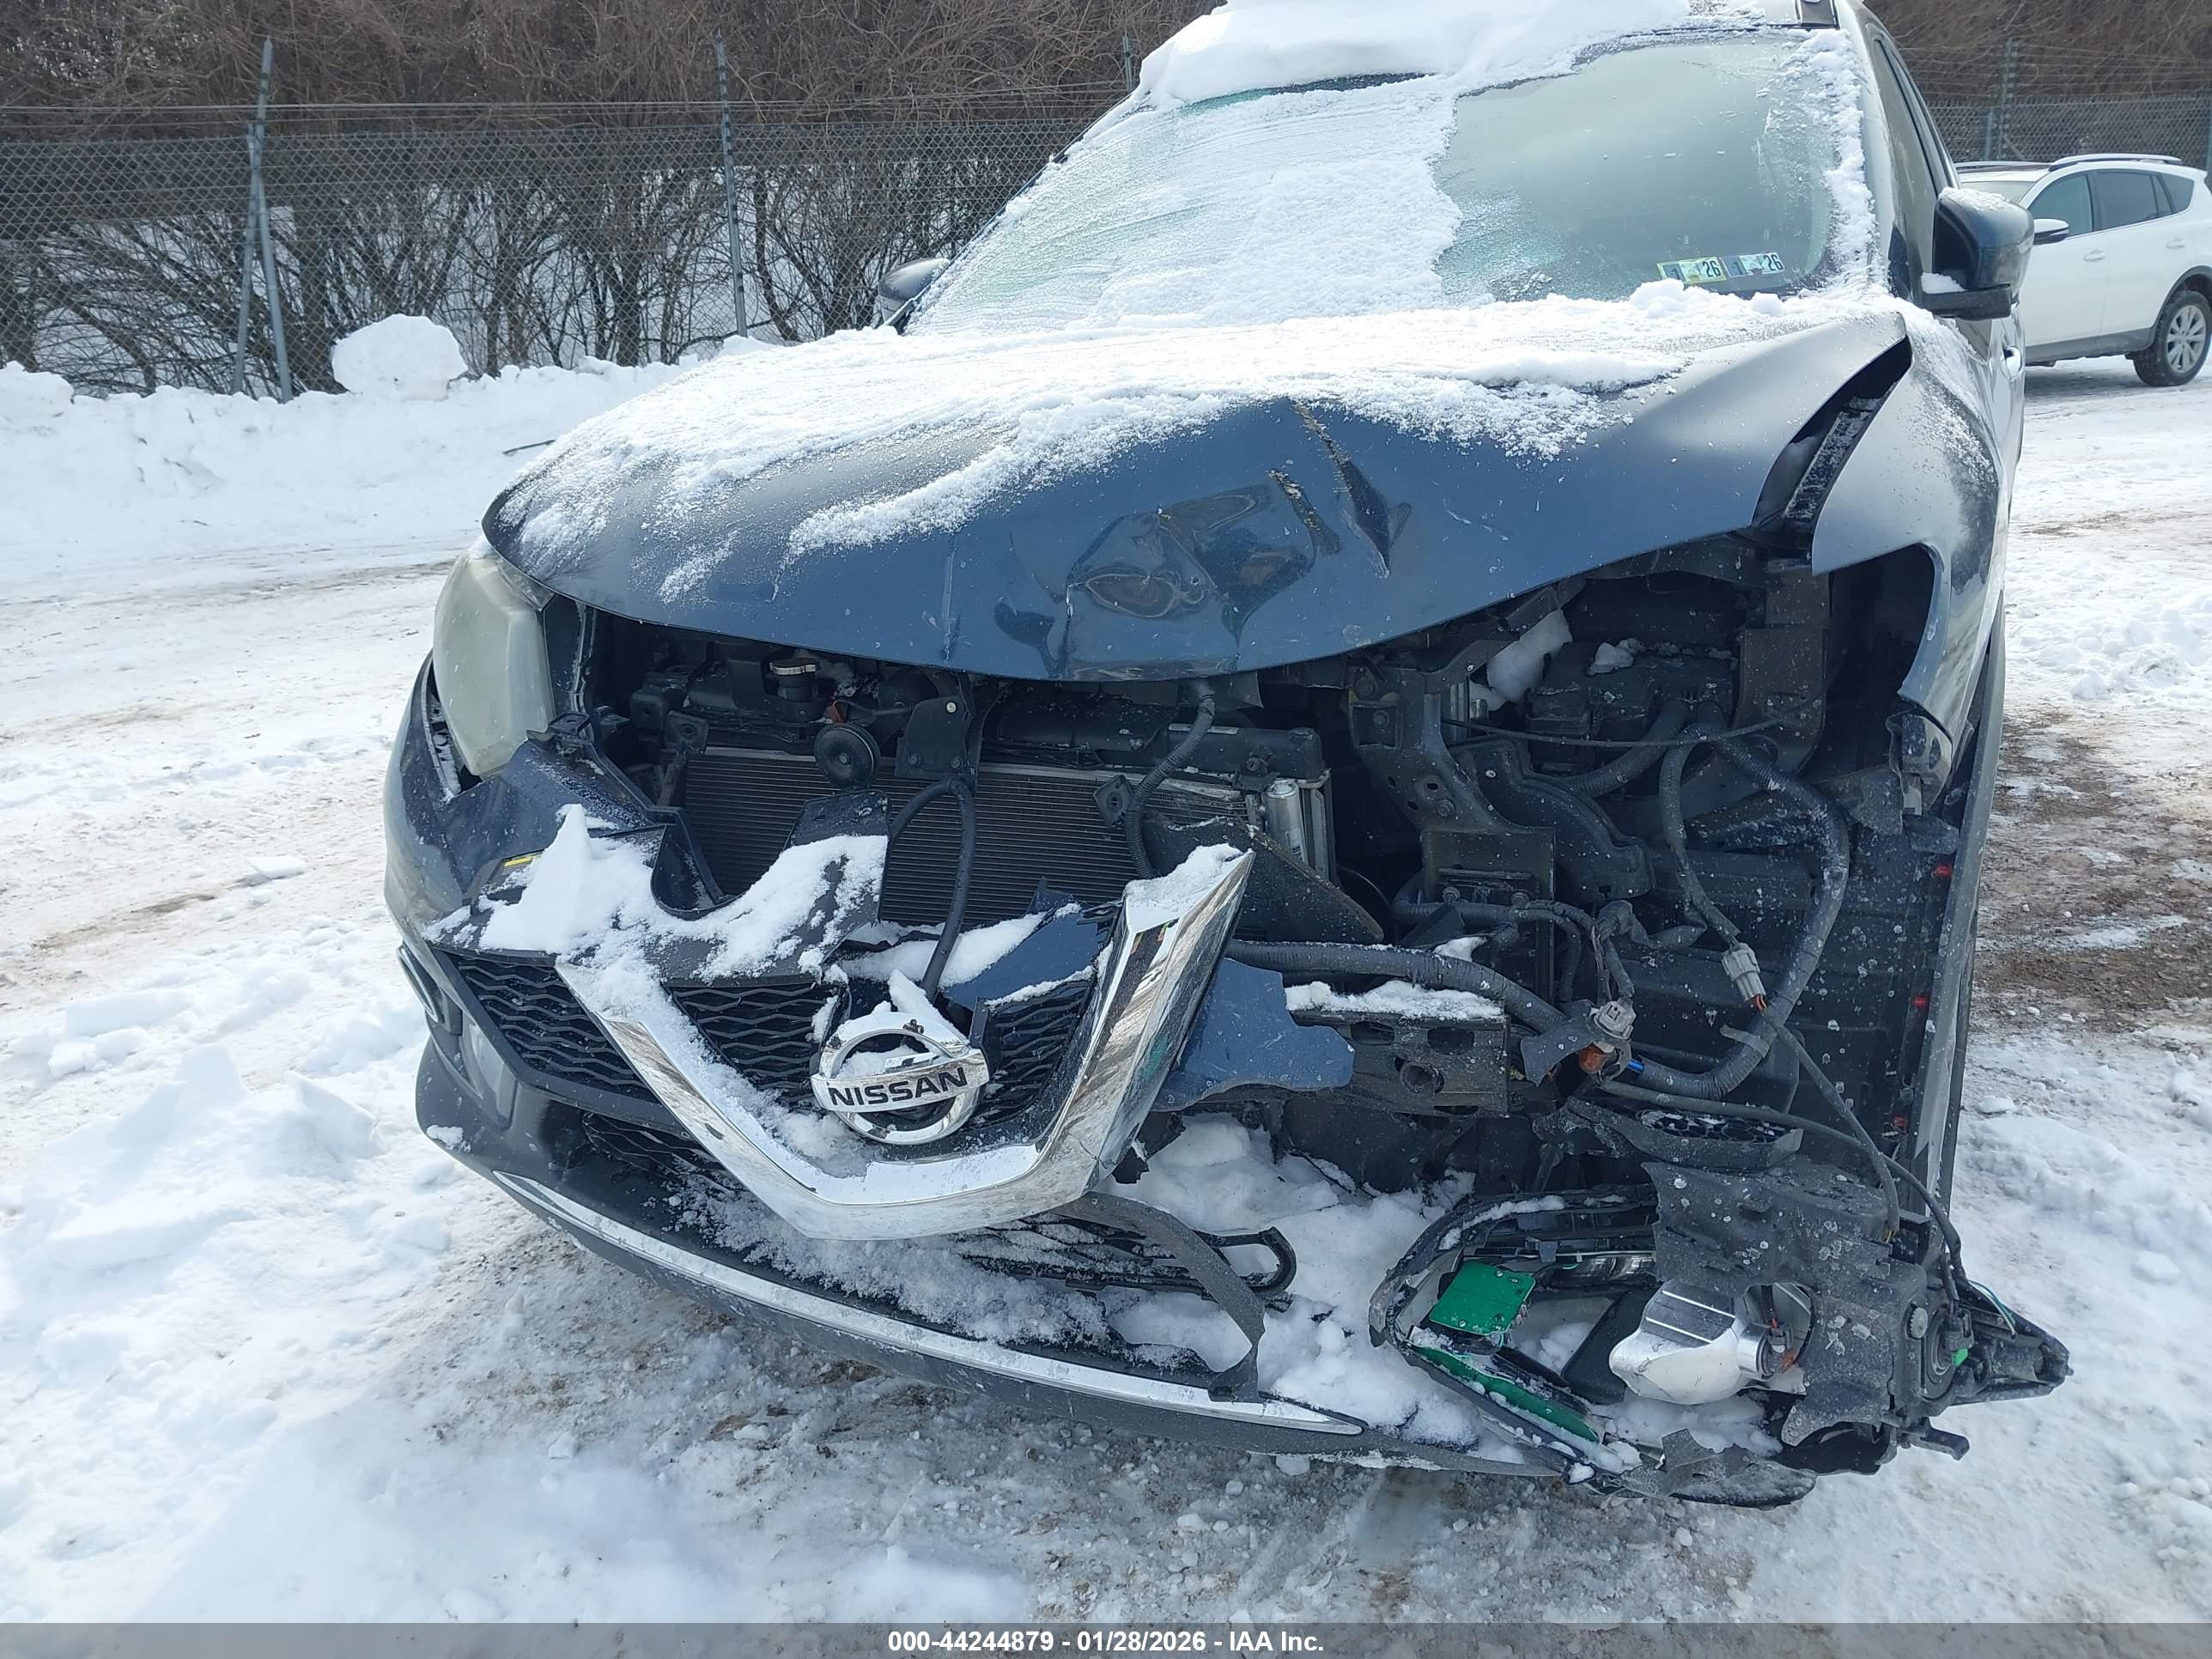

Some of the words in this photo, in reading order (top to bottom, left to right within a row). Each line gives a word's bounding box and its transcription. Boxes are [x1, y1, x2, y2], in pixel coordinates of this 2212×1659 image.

[1702, 260, 1722, 277] 26
[1764, 253, 1784, 271] 26
[827, 1066, 969, 1107] NISSAN
